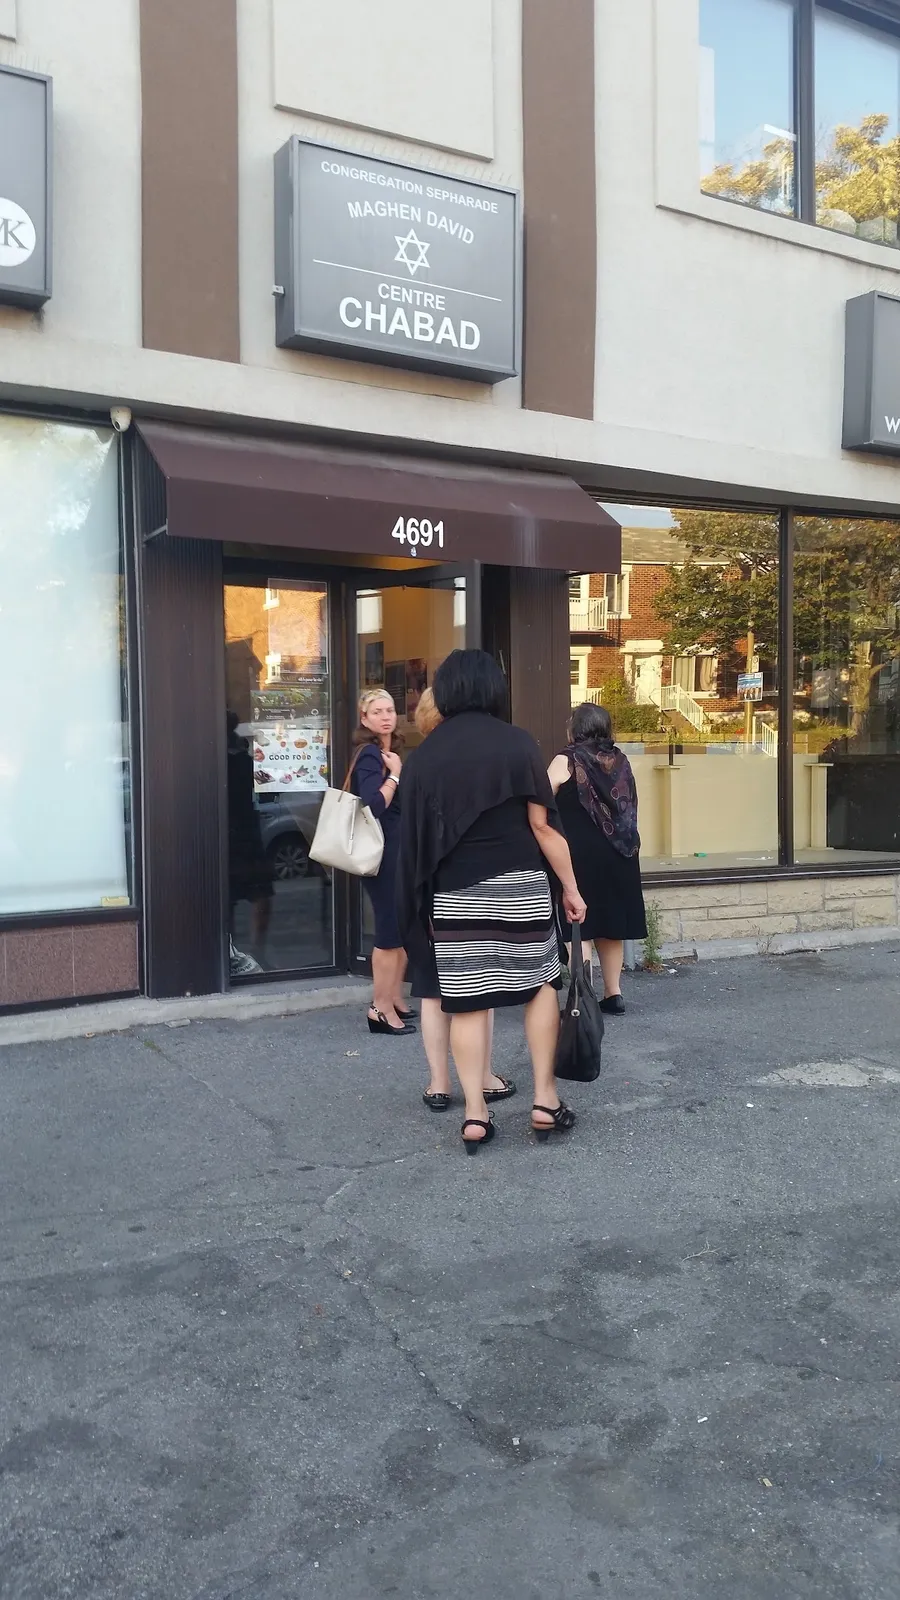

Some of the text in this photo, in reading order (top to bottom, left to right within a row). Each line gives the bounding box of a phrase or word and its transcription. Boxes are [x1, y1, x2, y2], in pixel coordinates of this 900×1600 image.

[321, 161, 498, 214] CONGREGATION SEPHARADE
[347, 200, 474, 244] MAGHEN DAVID
[378, 283, 446, 311] CENTRE
[339, 297, 481, 351] CHABAD
[391, 516, 444, 548] 4691
